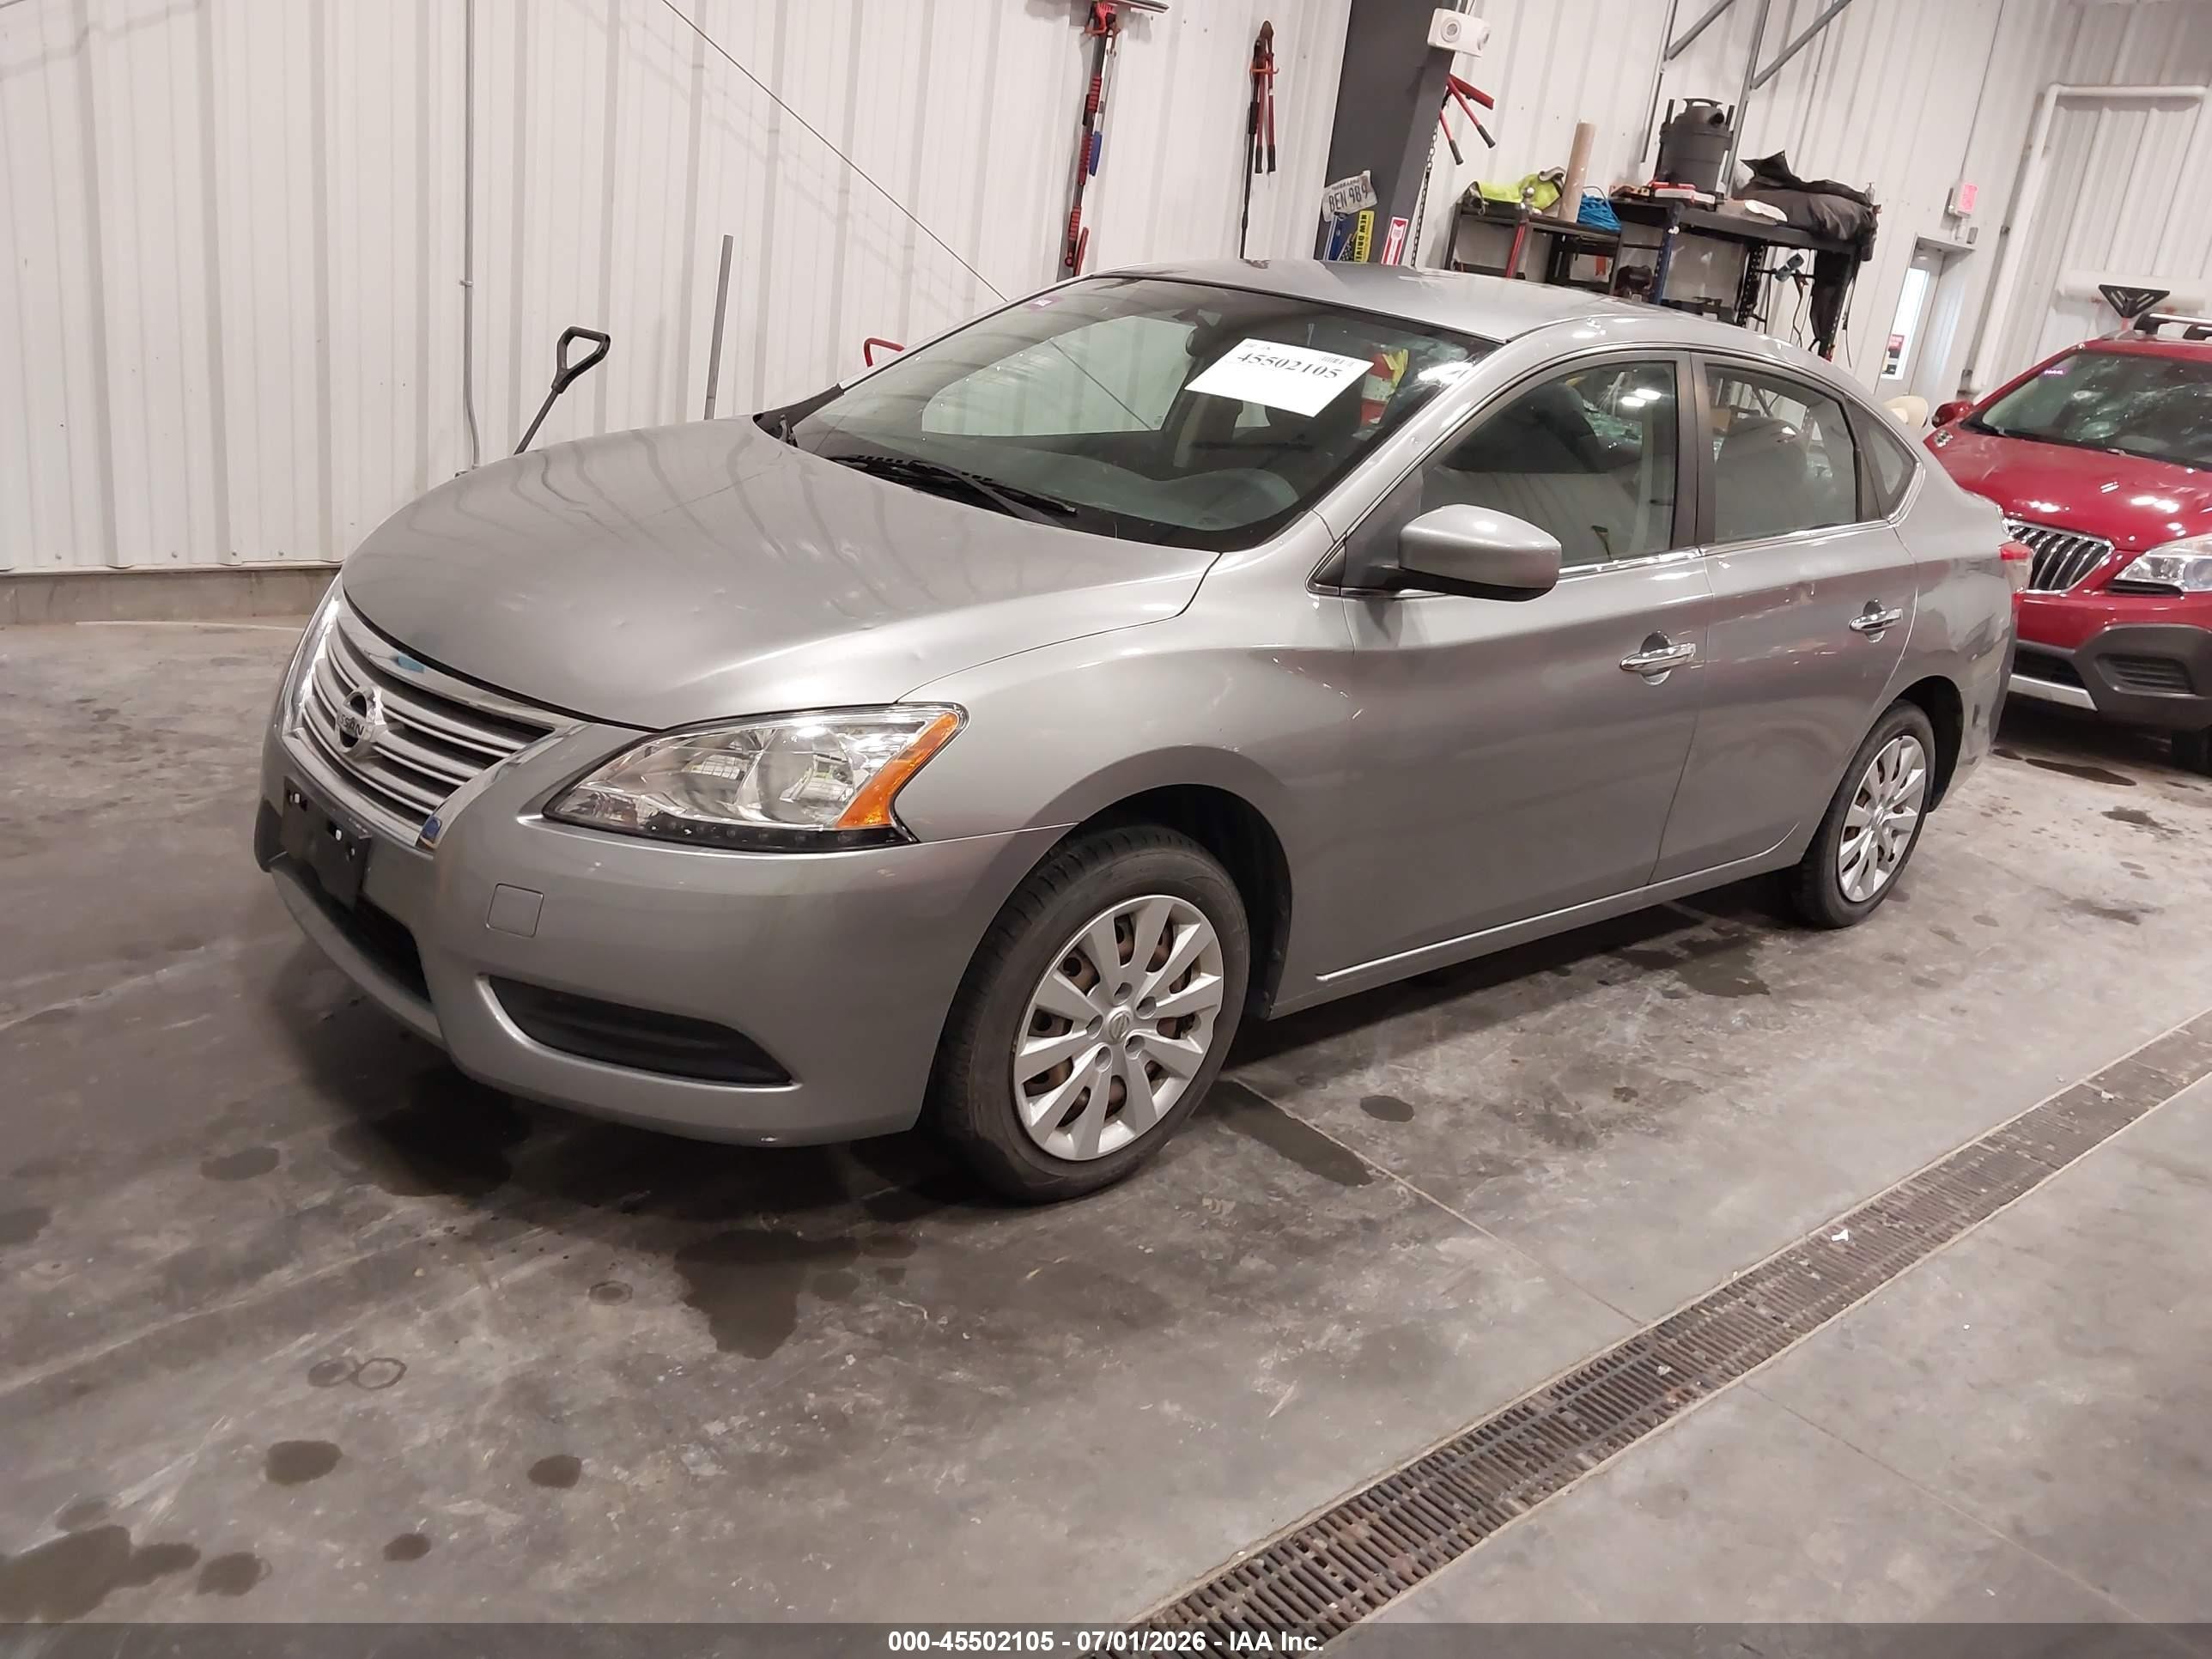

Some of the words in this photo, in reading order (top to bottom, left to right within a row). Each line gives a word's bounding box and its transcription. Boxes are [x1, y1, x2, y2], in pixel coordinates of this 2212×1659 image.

[1328, 191, 1347, 212] BEN
[1349, 185, 1368, 204] 989
[1358, 214, 1367, 233] NEW
[1355, 235, 1365, 262] DRIVE
[1237, 352, 1343, 379] 45502105
[339, 714, 365, 736] SSAN
